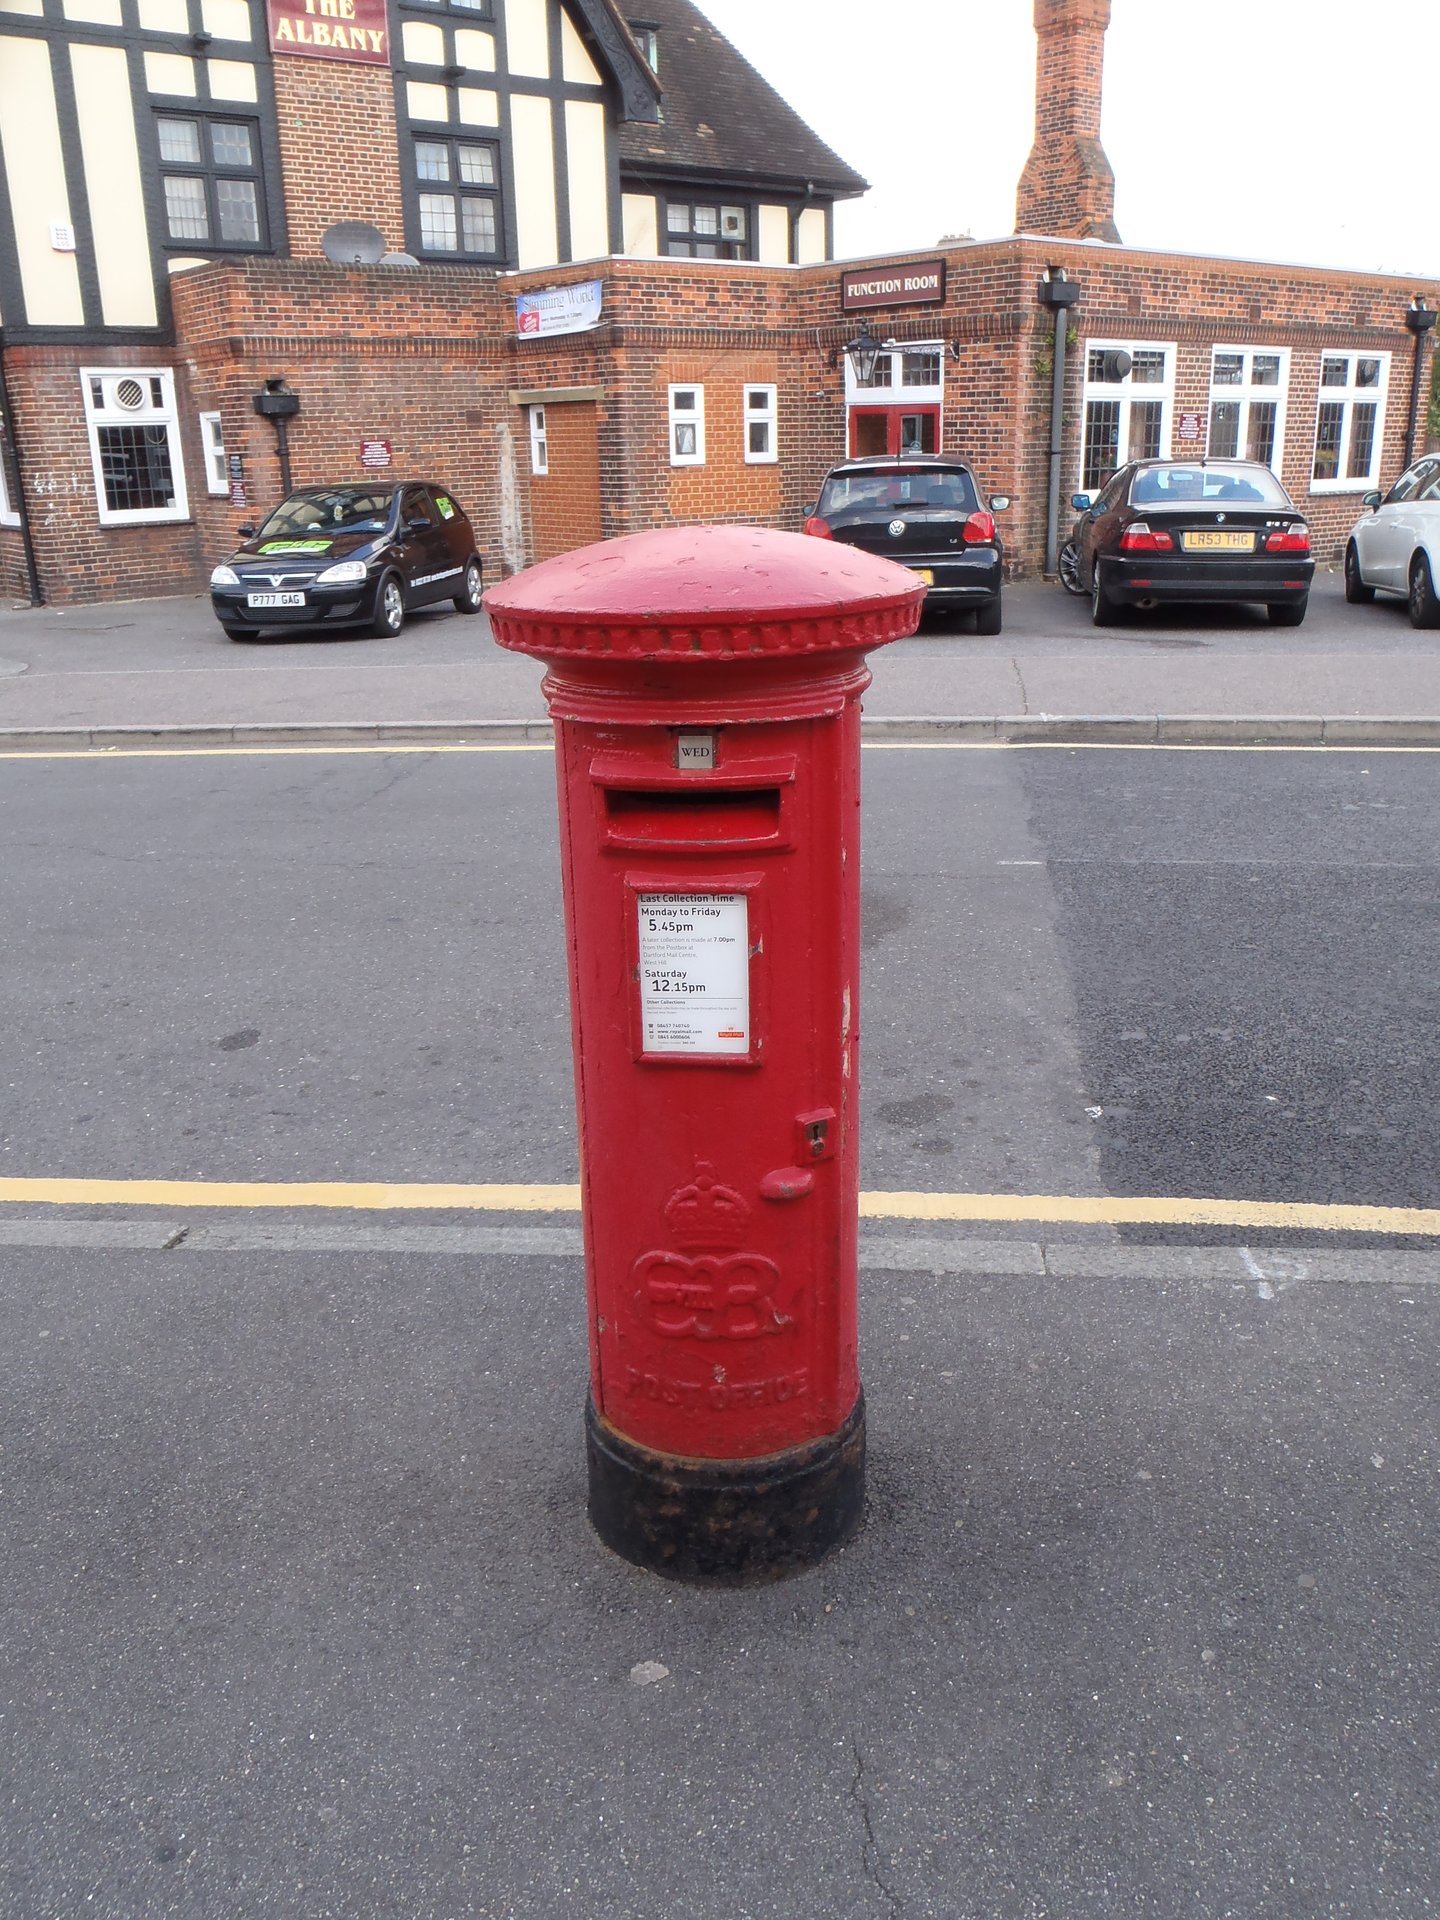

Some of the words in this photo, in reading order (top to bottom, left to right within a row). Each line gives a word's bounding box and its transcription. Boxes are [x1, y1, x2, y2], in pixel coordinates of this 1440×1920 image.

[305, 0, 356, 20] THE
[275, 17, 385, 53] ALBANY
[847, 279, 901, 297] FUNCTION
[904, 274, 938, 291] ROOM
[522, 295, 565, 313] Slimming
[566, 283, 595, 304] World
[1189, 533, 1222, 546] LR53
[1225, 533, 1249, 546] THG
[252, 594, 276, 605] P777
[281, 594, 301, 604] GAG
[681, 747, 710, 757] WED
[640, 894, 662, 903] Last
[662, 894, 708, 903] Collection
[710, 894, 735, 903] Time
[641, 907, 678, 918] Monday
[680, 908, 690, 916] to
[691, 907, 721, 918] Friday
[648, 918, 694, 933] 5.45pm
[645, 969, 687, 979] Saturday
[652, 979, 706, 993] 12.15pm
